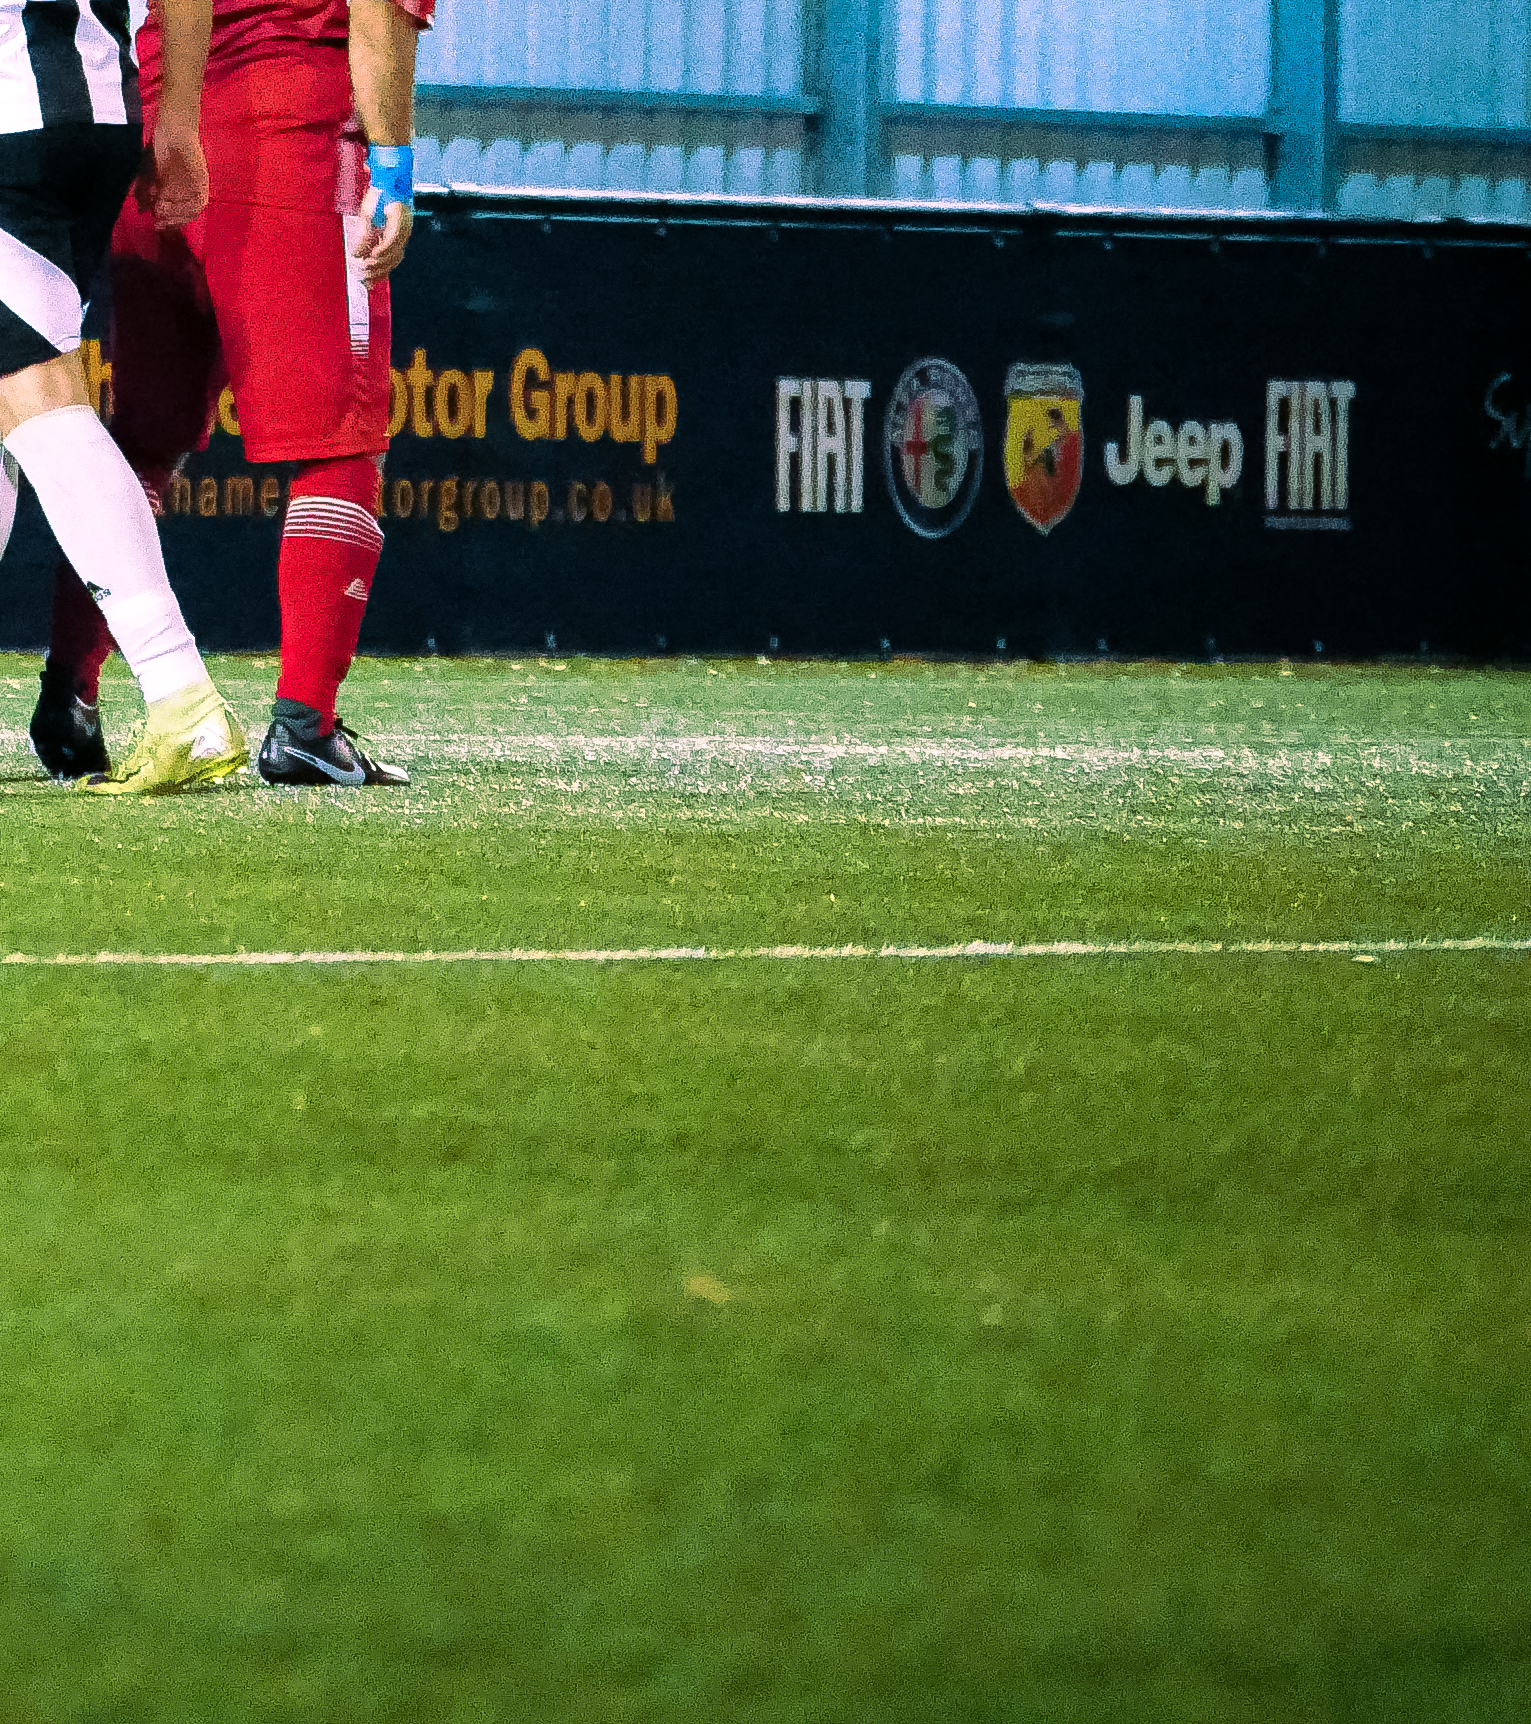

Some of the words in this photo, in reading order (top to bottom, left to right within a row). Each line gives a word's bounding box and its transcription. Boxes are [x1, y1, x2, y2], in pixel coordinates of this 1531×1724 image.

[388, 347, 494, 439] otor
[507, 347, 678, 464] Group
[775, 377, 871, 514] FIAT
[1104, 394, 1244, 506] Jeep
[1264, 379, 1357, 511] FIAT
